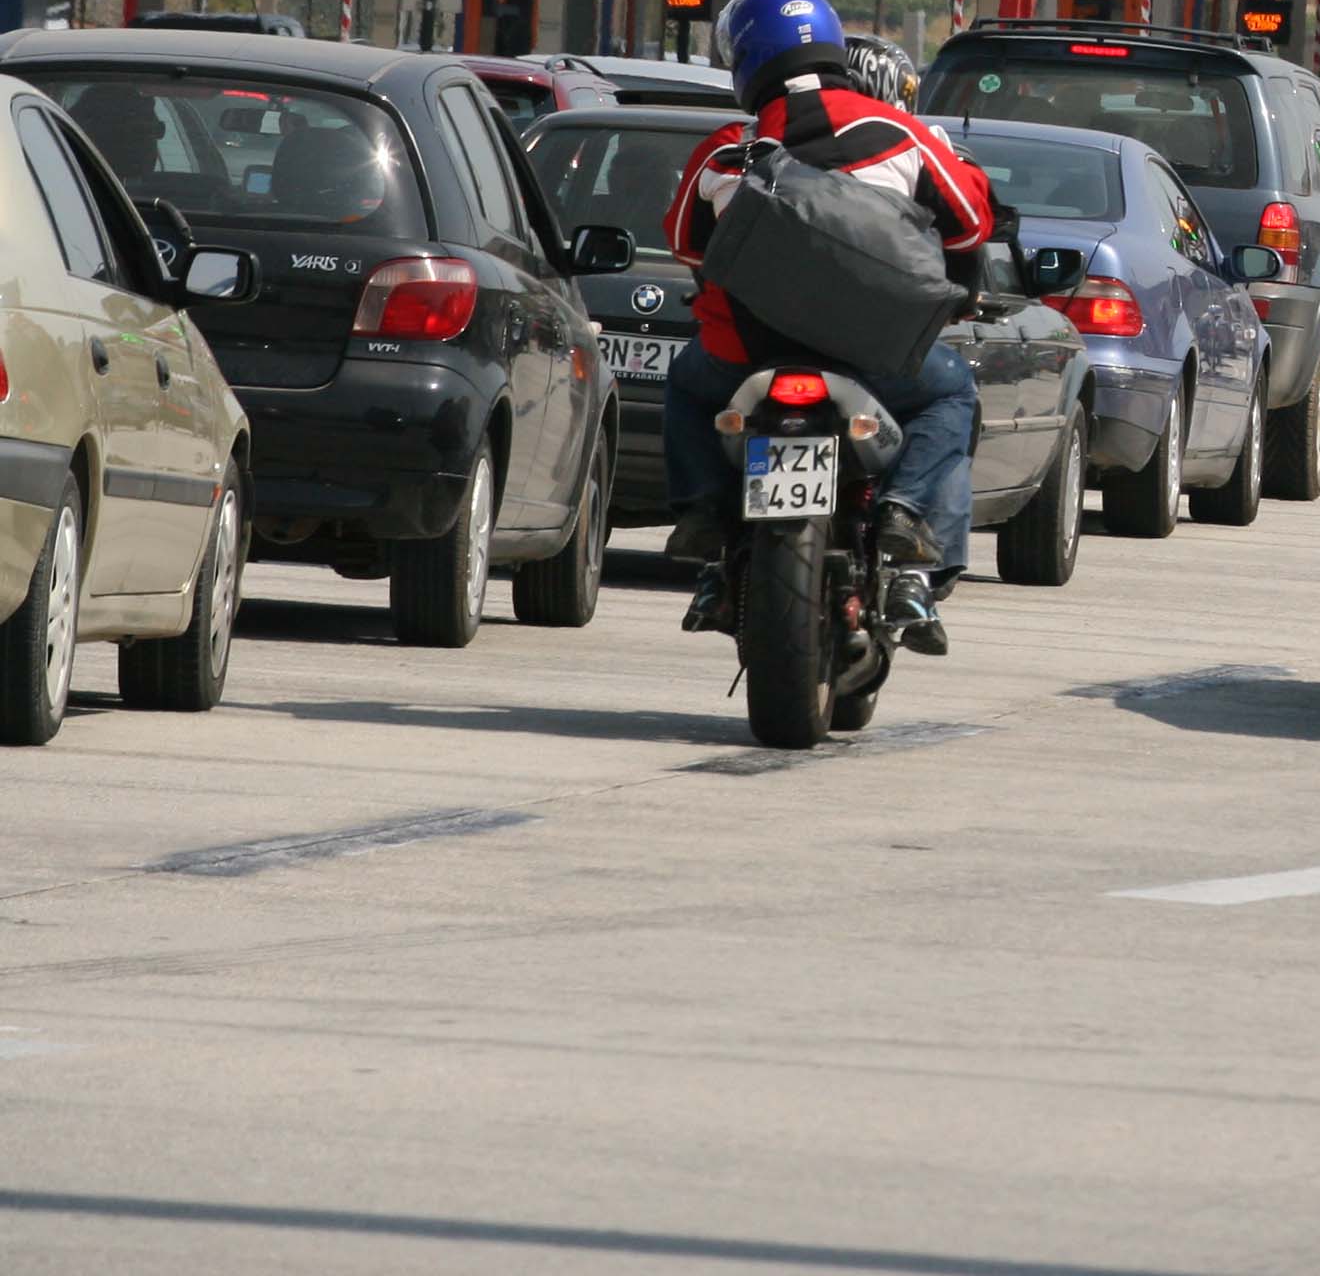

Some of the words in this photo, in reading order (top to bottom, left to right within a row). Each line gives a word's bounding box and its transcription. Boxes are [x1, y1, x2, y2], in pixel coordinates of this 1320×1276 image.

[291, 254, 339, 271] YARIS
[750, 462, 766, 471] GR
[770, 445, 834, 472] XZK
[769, 482, 828, 509] 494
